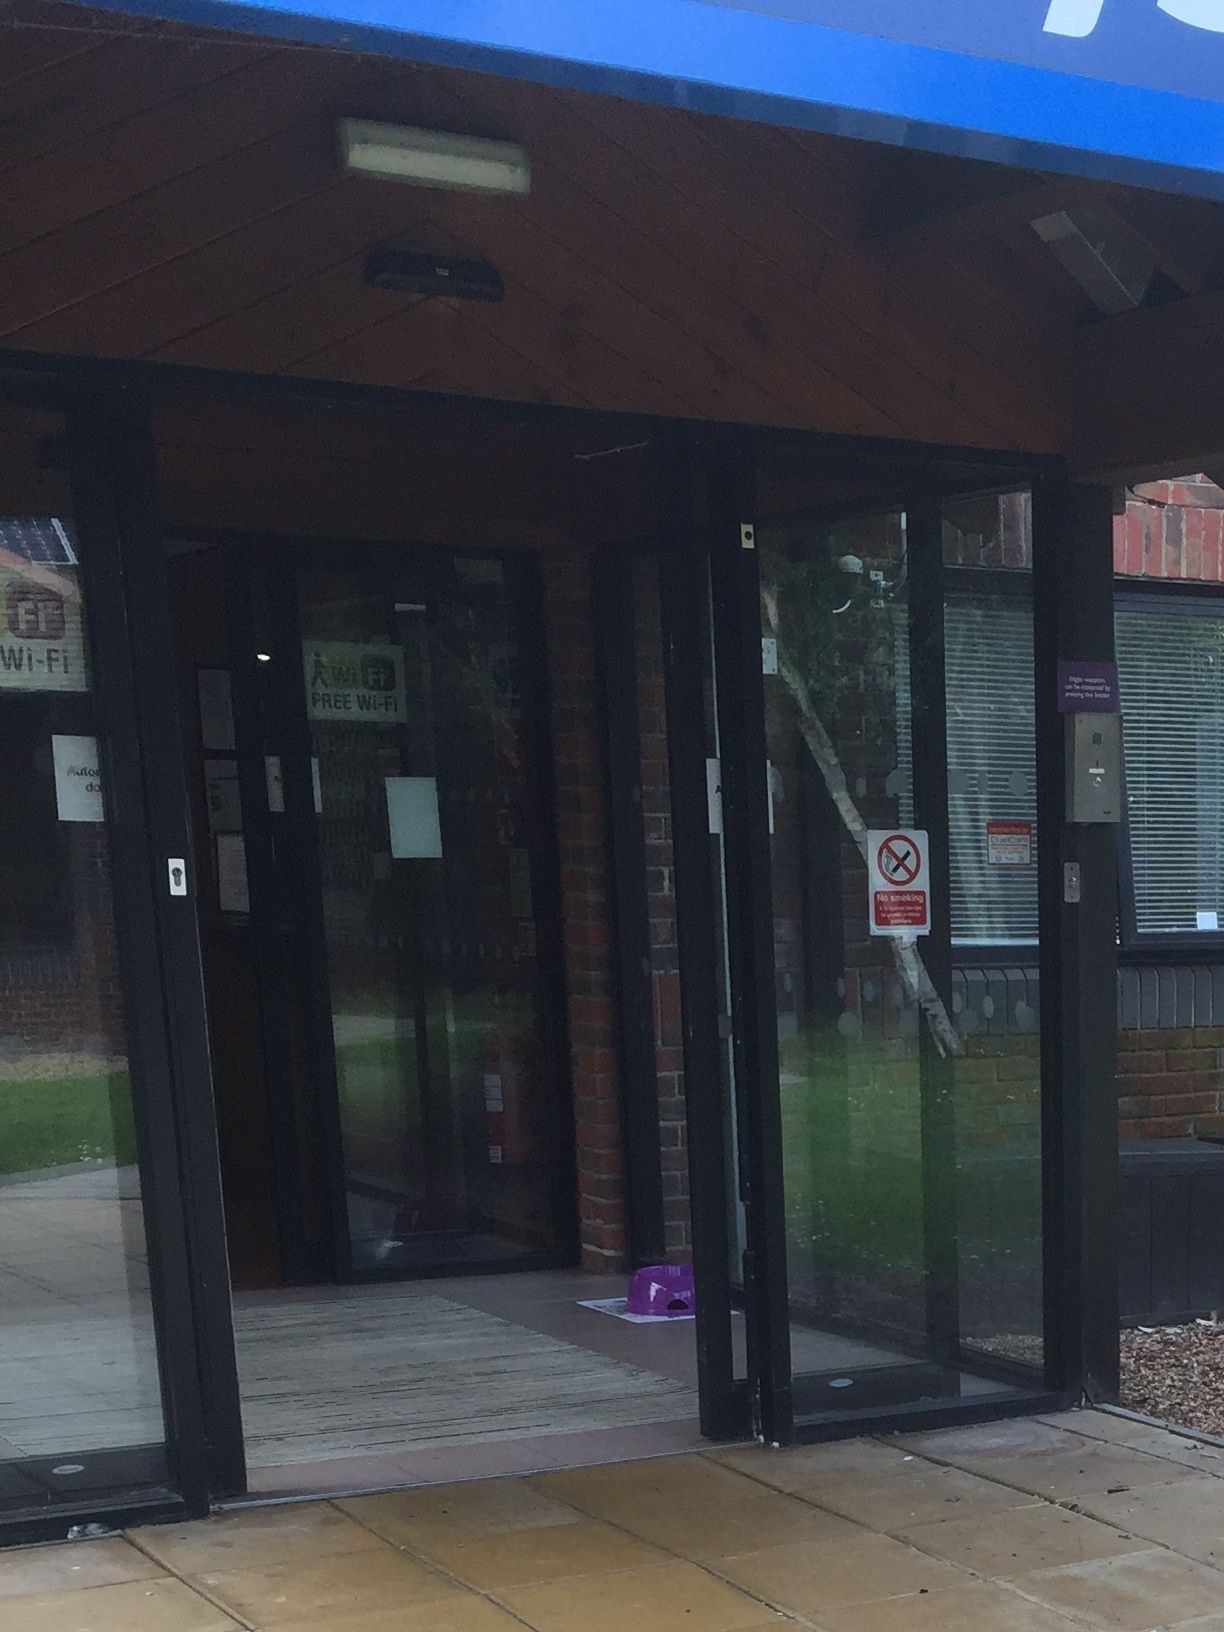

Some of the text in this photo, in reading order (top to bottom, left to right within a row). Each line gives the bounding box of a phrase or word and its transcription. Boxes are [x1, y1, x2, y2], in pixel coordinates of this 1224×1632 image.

[0, 644, 69, 675] Wi-Fi
[311, 692, 398, 712] FREE Wi-Fi
